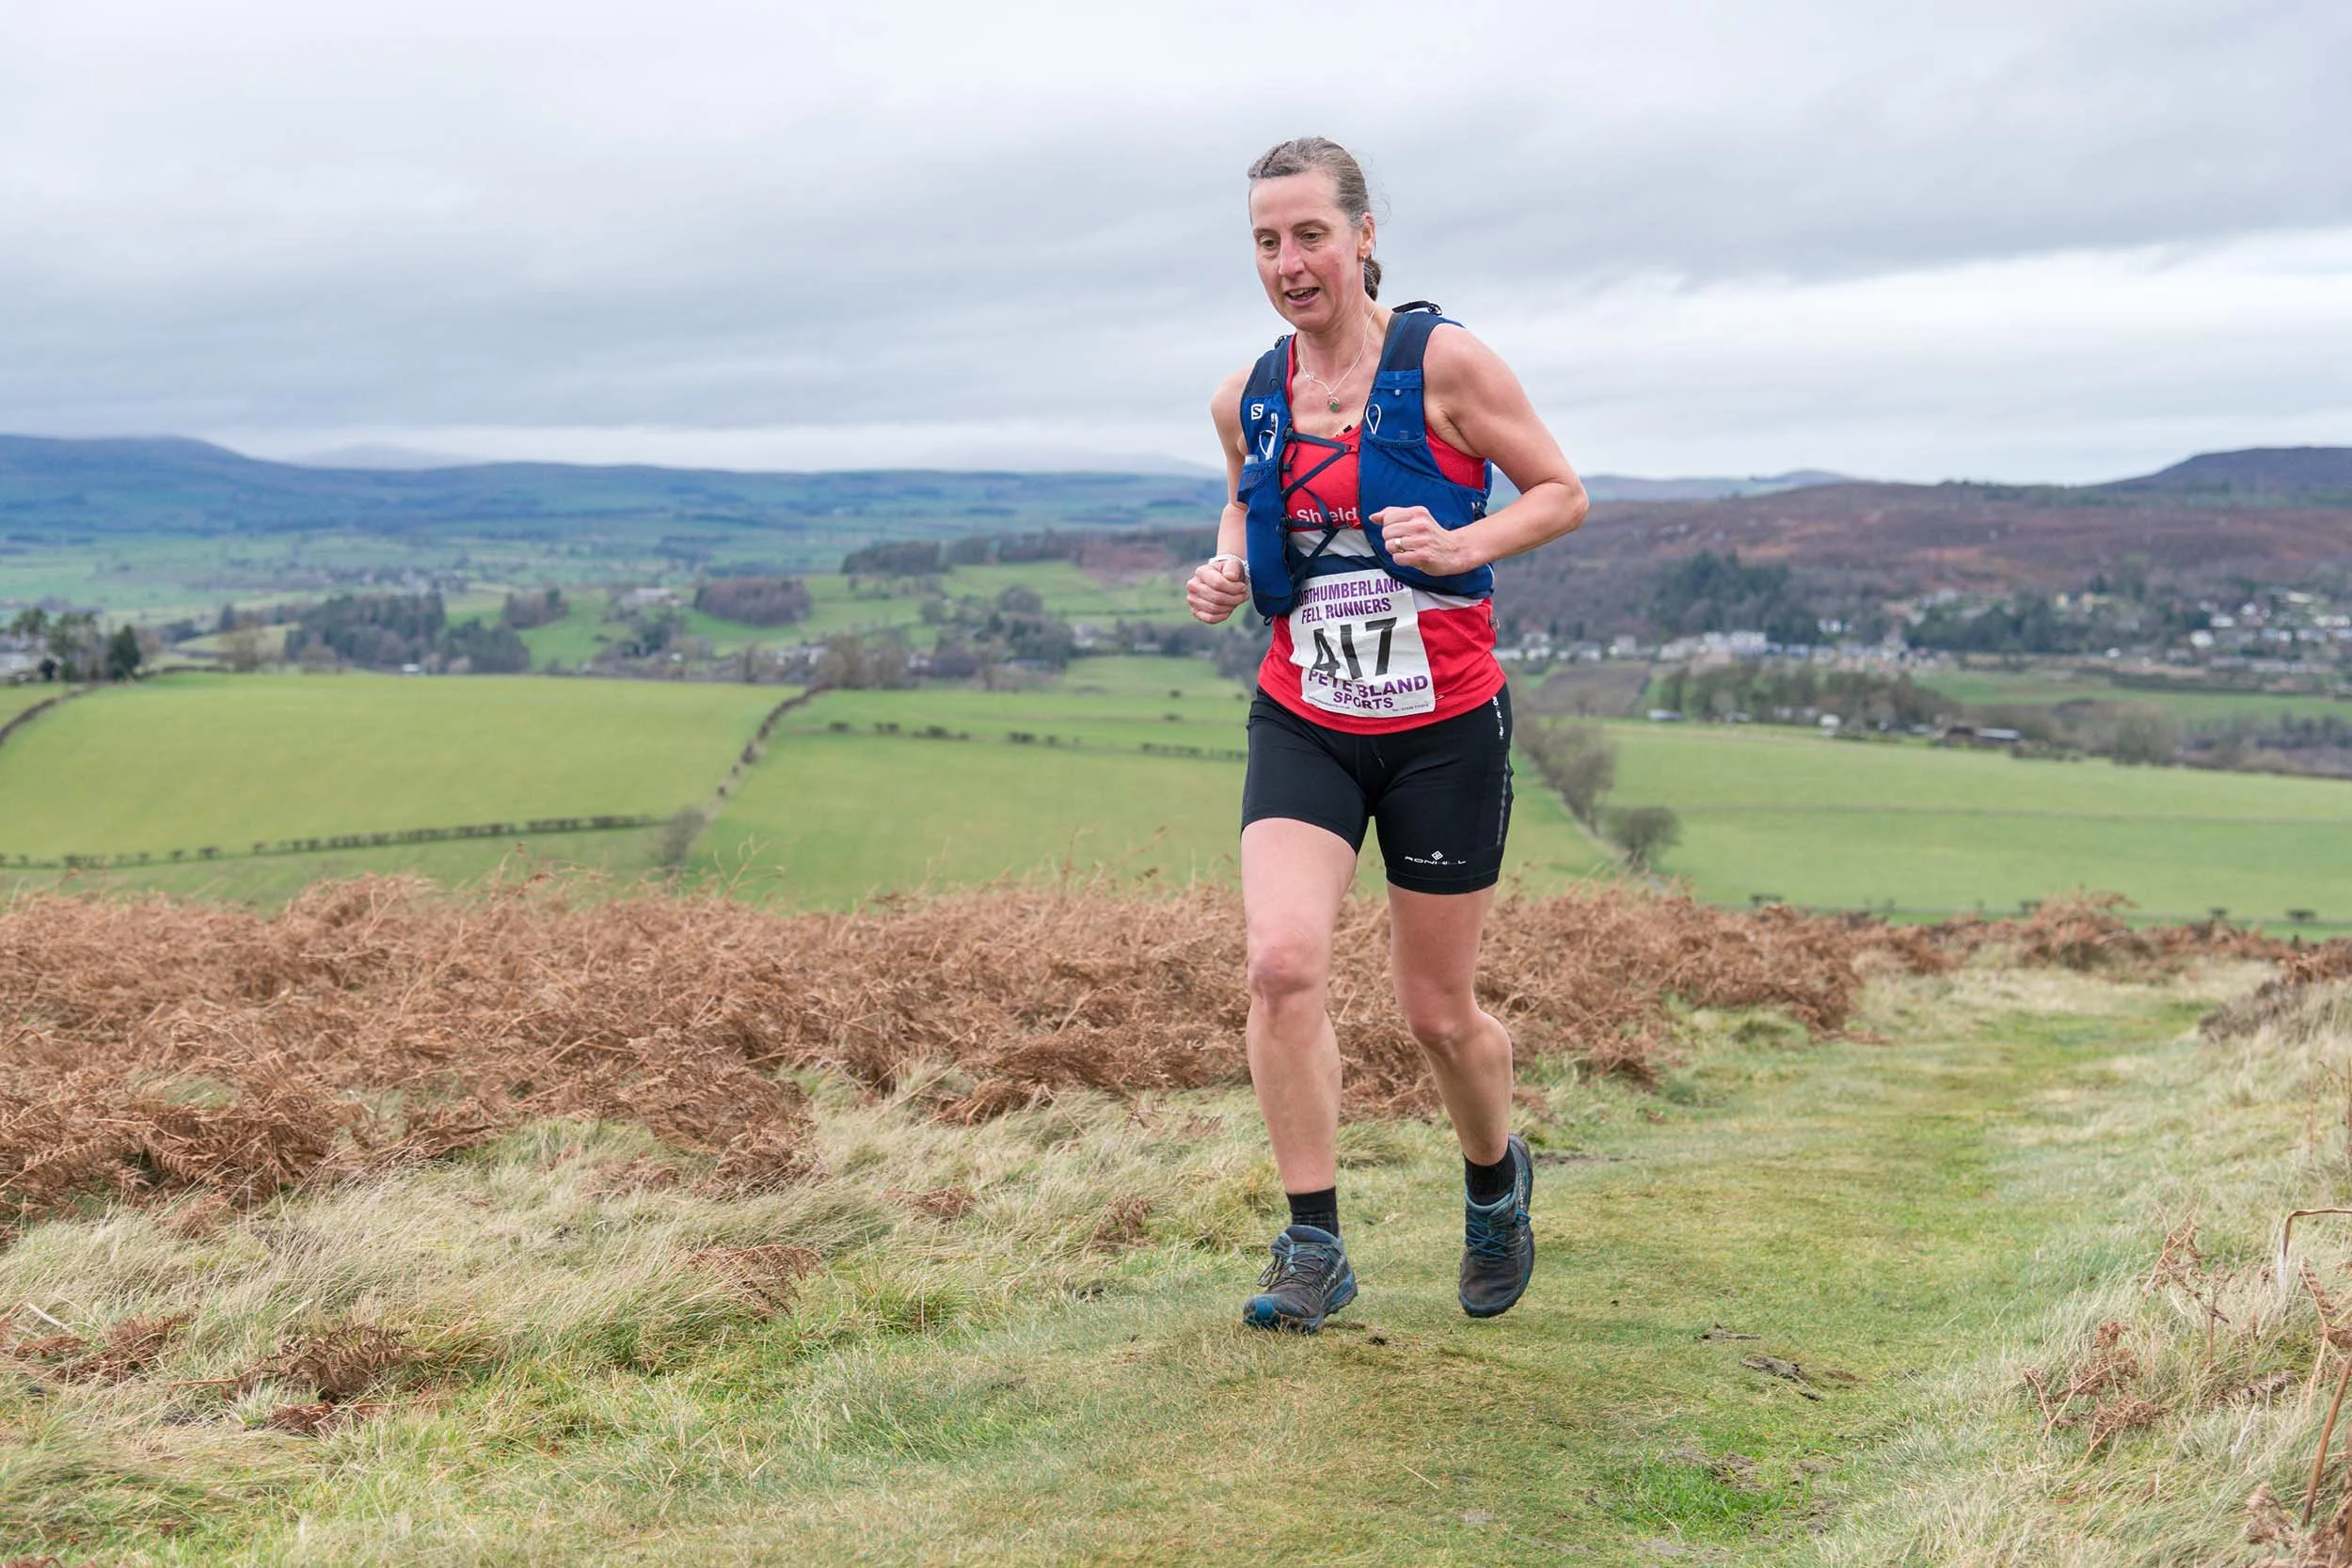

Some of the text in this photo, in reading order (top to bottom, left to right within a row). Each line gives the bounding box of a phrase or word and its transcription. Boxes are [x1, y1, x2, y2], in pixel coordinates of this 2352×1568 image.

[1296, 507, 1358, 524] Sheld
[1295, 578, 1405, 608] ORTHUMBERLAND
[1301, 597, 1391, 625] FELL RUNNERS
[1311, 616, 1398, 680] 417
[1308, 670, 1428, 698] PETE BLAND
[1333, 691, 1393, 709] SPORTS
